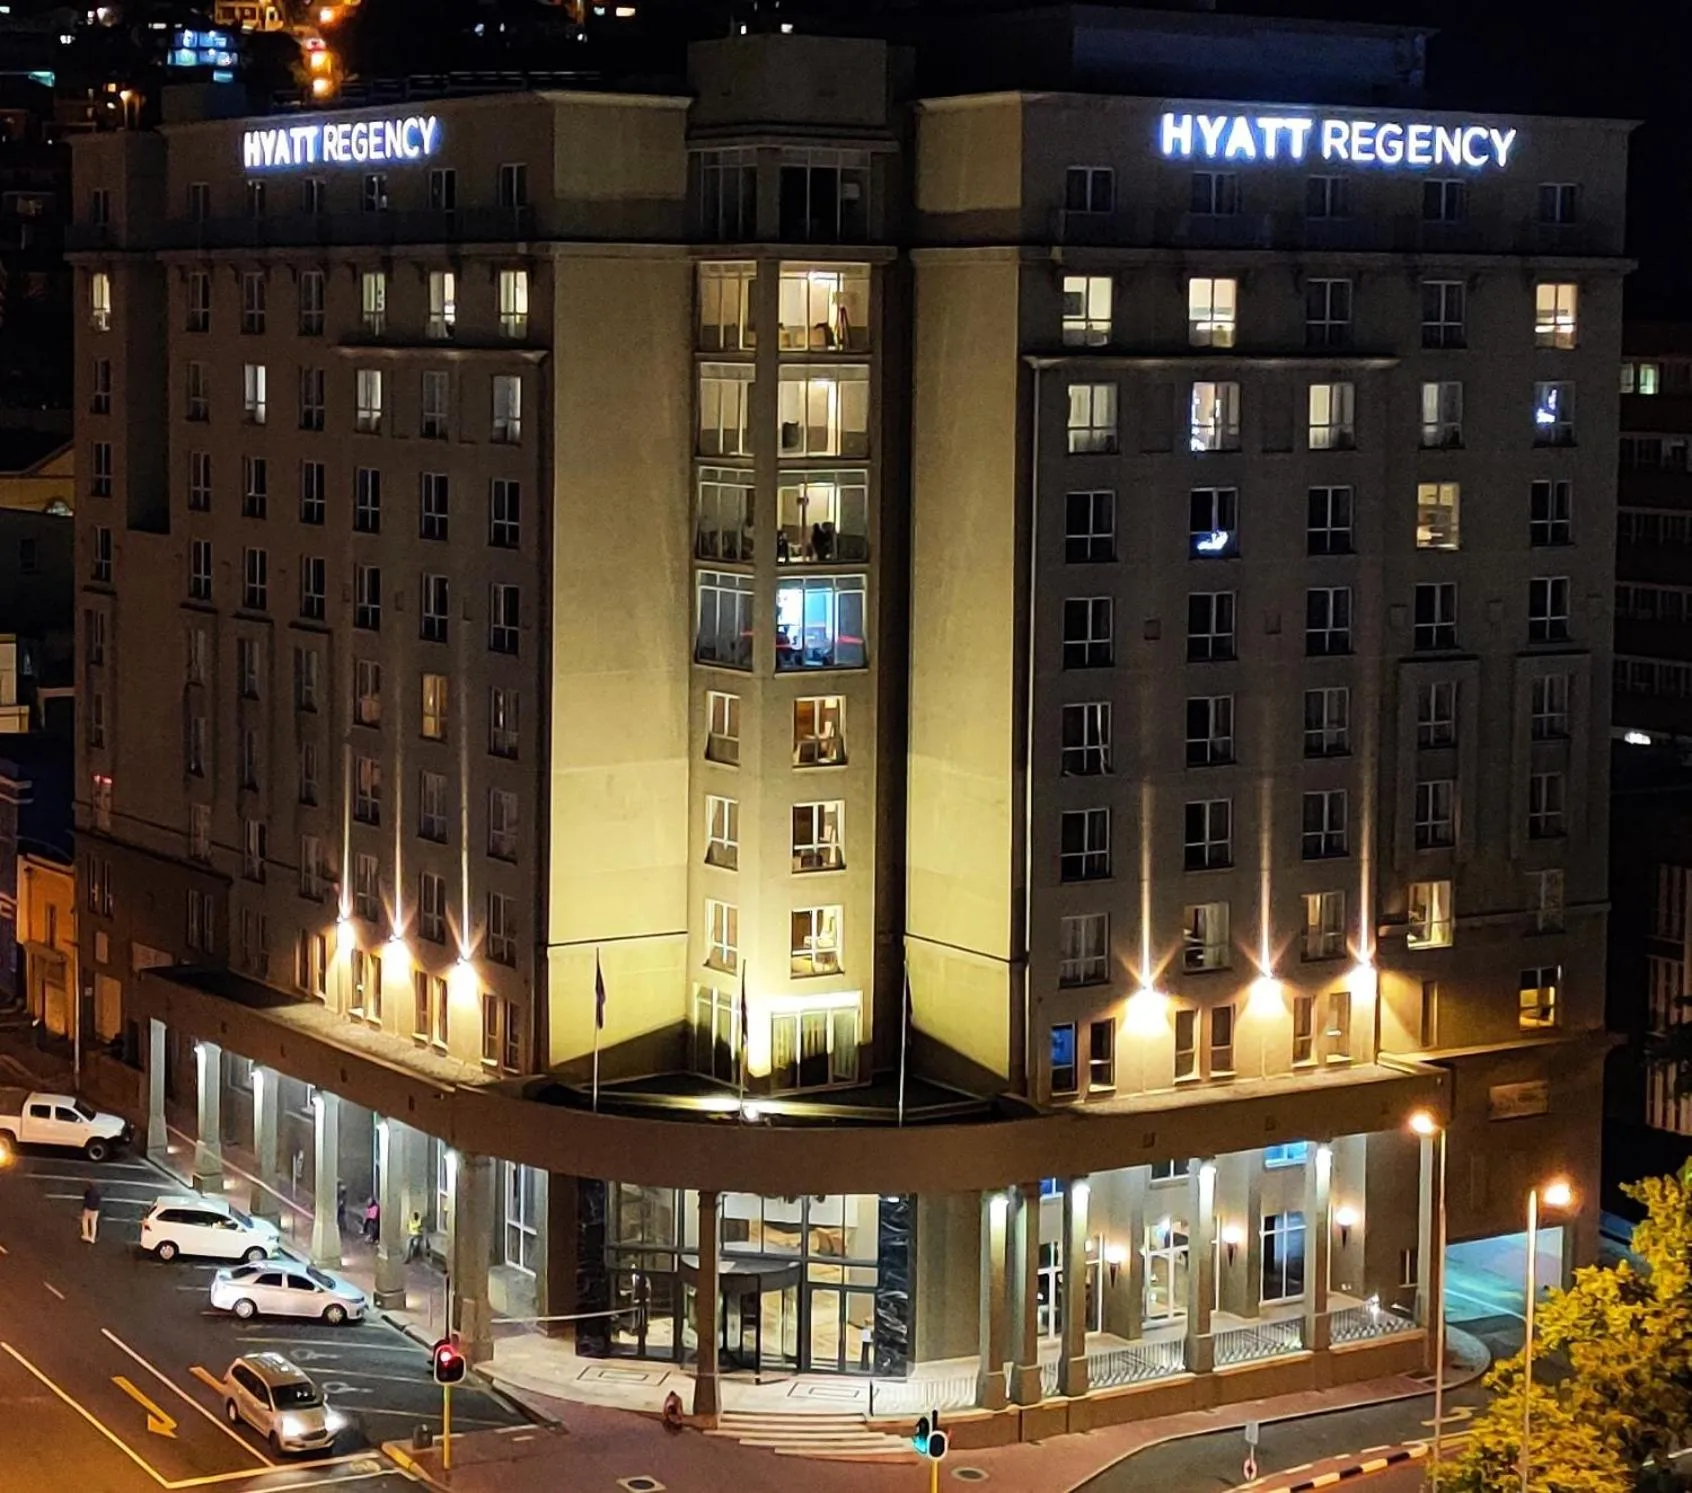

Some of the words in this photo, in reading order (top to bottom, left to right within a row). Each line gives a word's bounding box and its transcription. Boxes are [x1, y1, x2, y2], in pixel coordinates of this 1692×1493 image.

[243, 125, 319, 168] HYATT
[322, 115, 437, 163] REGENCY
[1162, 112, 1312, 158] HYATT
[1321, 119, 1517, 166] REGENCY
